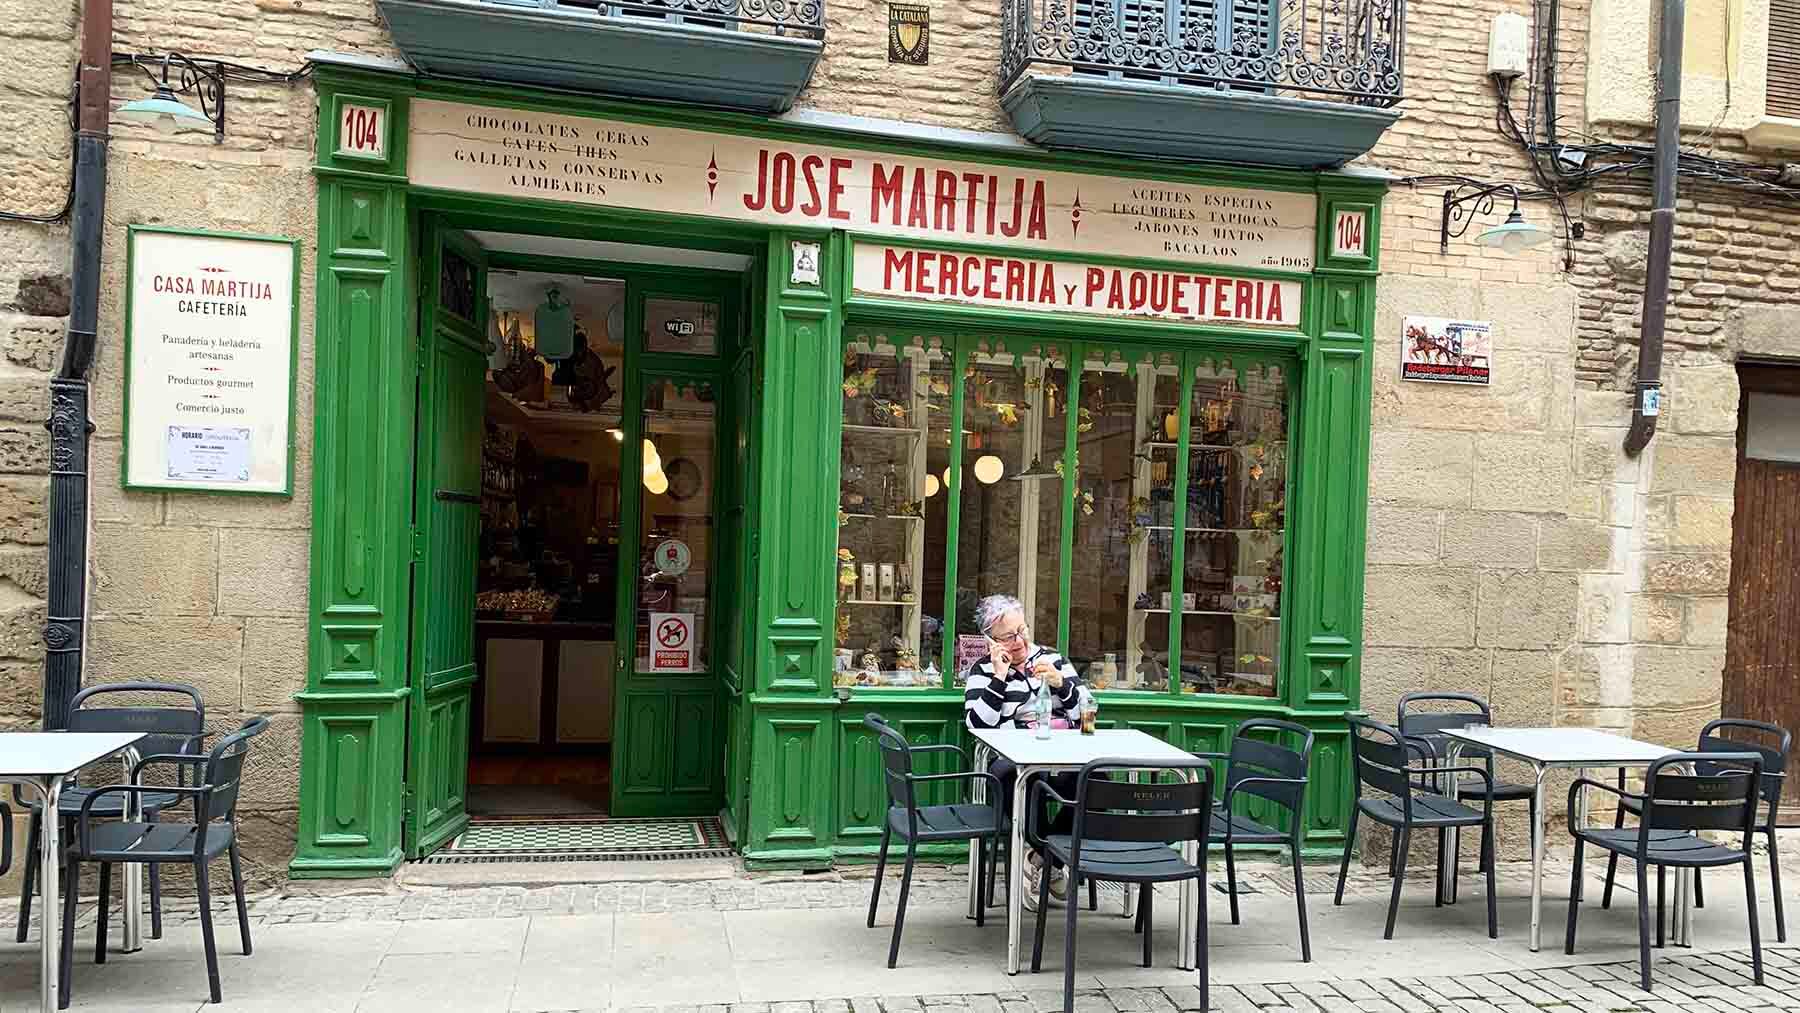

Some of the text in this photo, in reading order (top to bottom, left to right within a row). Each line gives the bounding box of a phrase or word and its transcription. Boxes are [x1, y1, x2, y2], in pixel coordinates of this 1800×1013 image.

[890, 10, 929, 23] LA CATALANA
[346, 108, 377, 151] 104
[467, 115, 649, 147] CHOCOLATES CERAS
[503, 137, 617, 161] CAFES THES
[454, 150, 664, 185] GALLETAS CONSERVAS
[508, 175, 607, 196] ALMIBARES
[743, 149, 1048, 241] JOSE MARTIJA
[1131, 188, 1273, 211] ACEITES ESPECIAS
[1112, 203, 1279, 228] LEGUMBRES TAPIOCAS
[1134, 221, 1200, 237] JABONES
[1338, 214, 1361, 250] 104
[1164, 240, 1238, 257] BACALAOS
[1260, 256, 1310, 268] año 1905
[153, 275, 273, 301] CASA MARTIJA
[883, 248, 1056, 305] MERCERIA
[1085, 266, 1283, 322] PAQUETERIA
[178, 300, 248, 317] CAFETERÍA
[162, 334, 261, 350] Panadería y heladería
[188, 351, 234, 361] artesanas
[167, 375, 254, 389] Productos gourmet
[175, 402, 245, 415] Comercio justo
[657, 651, 688, 659] PROHIBIDO
